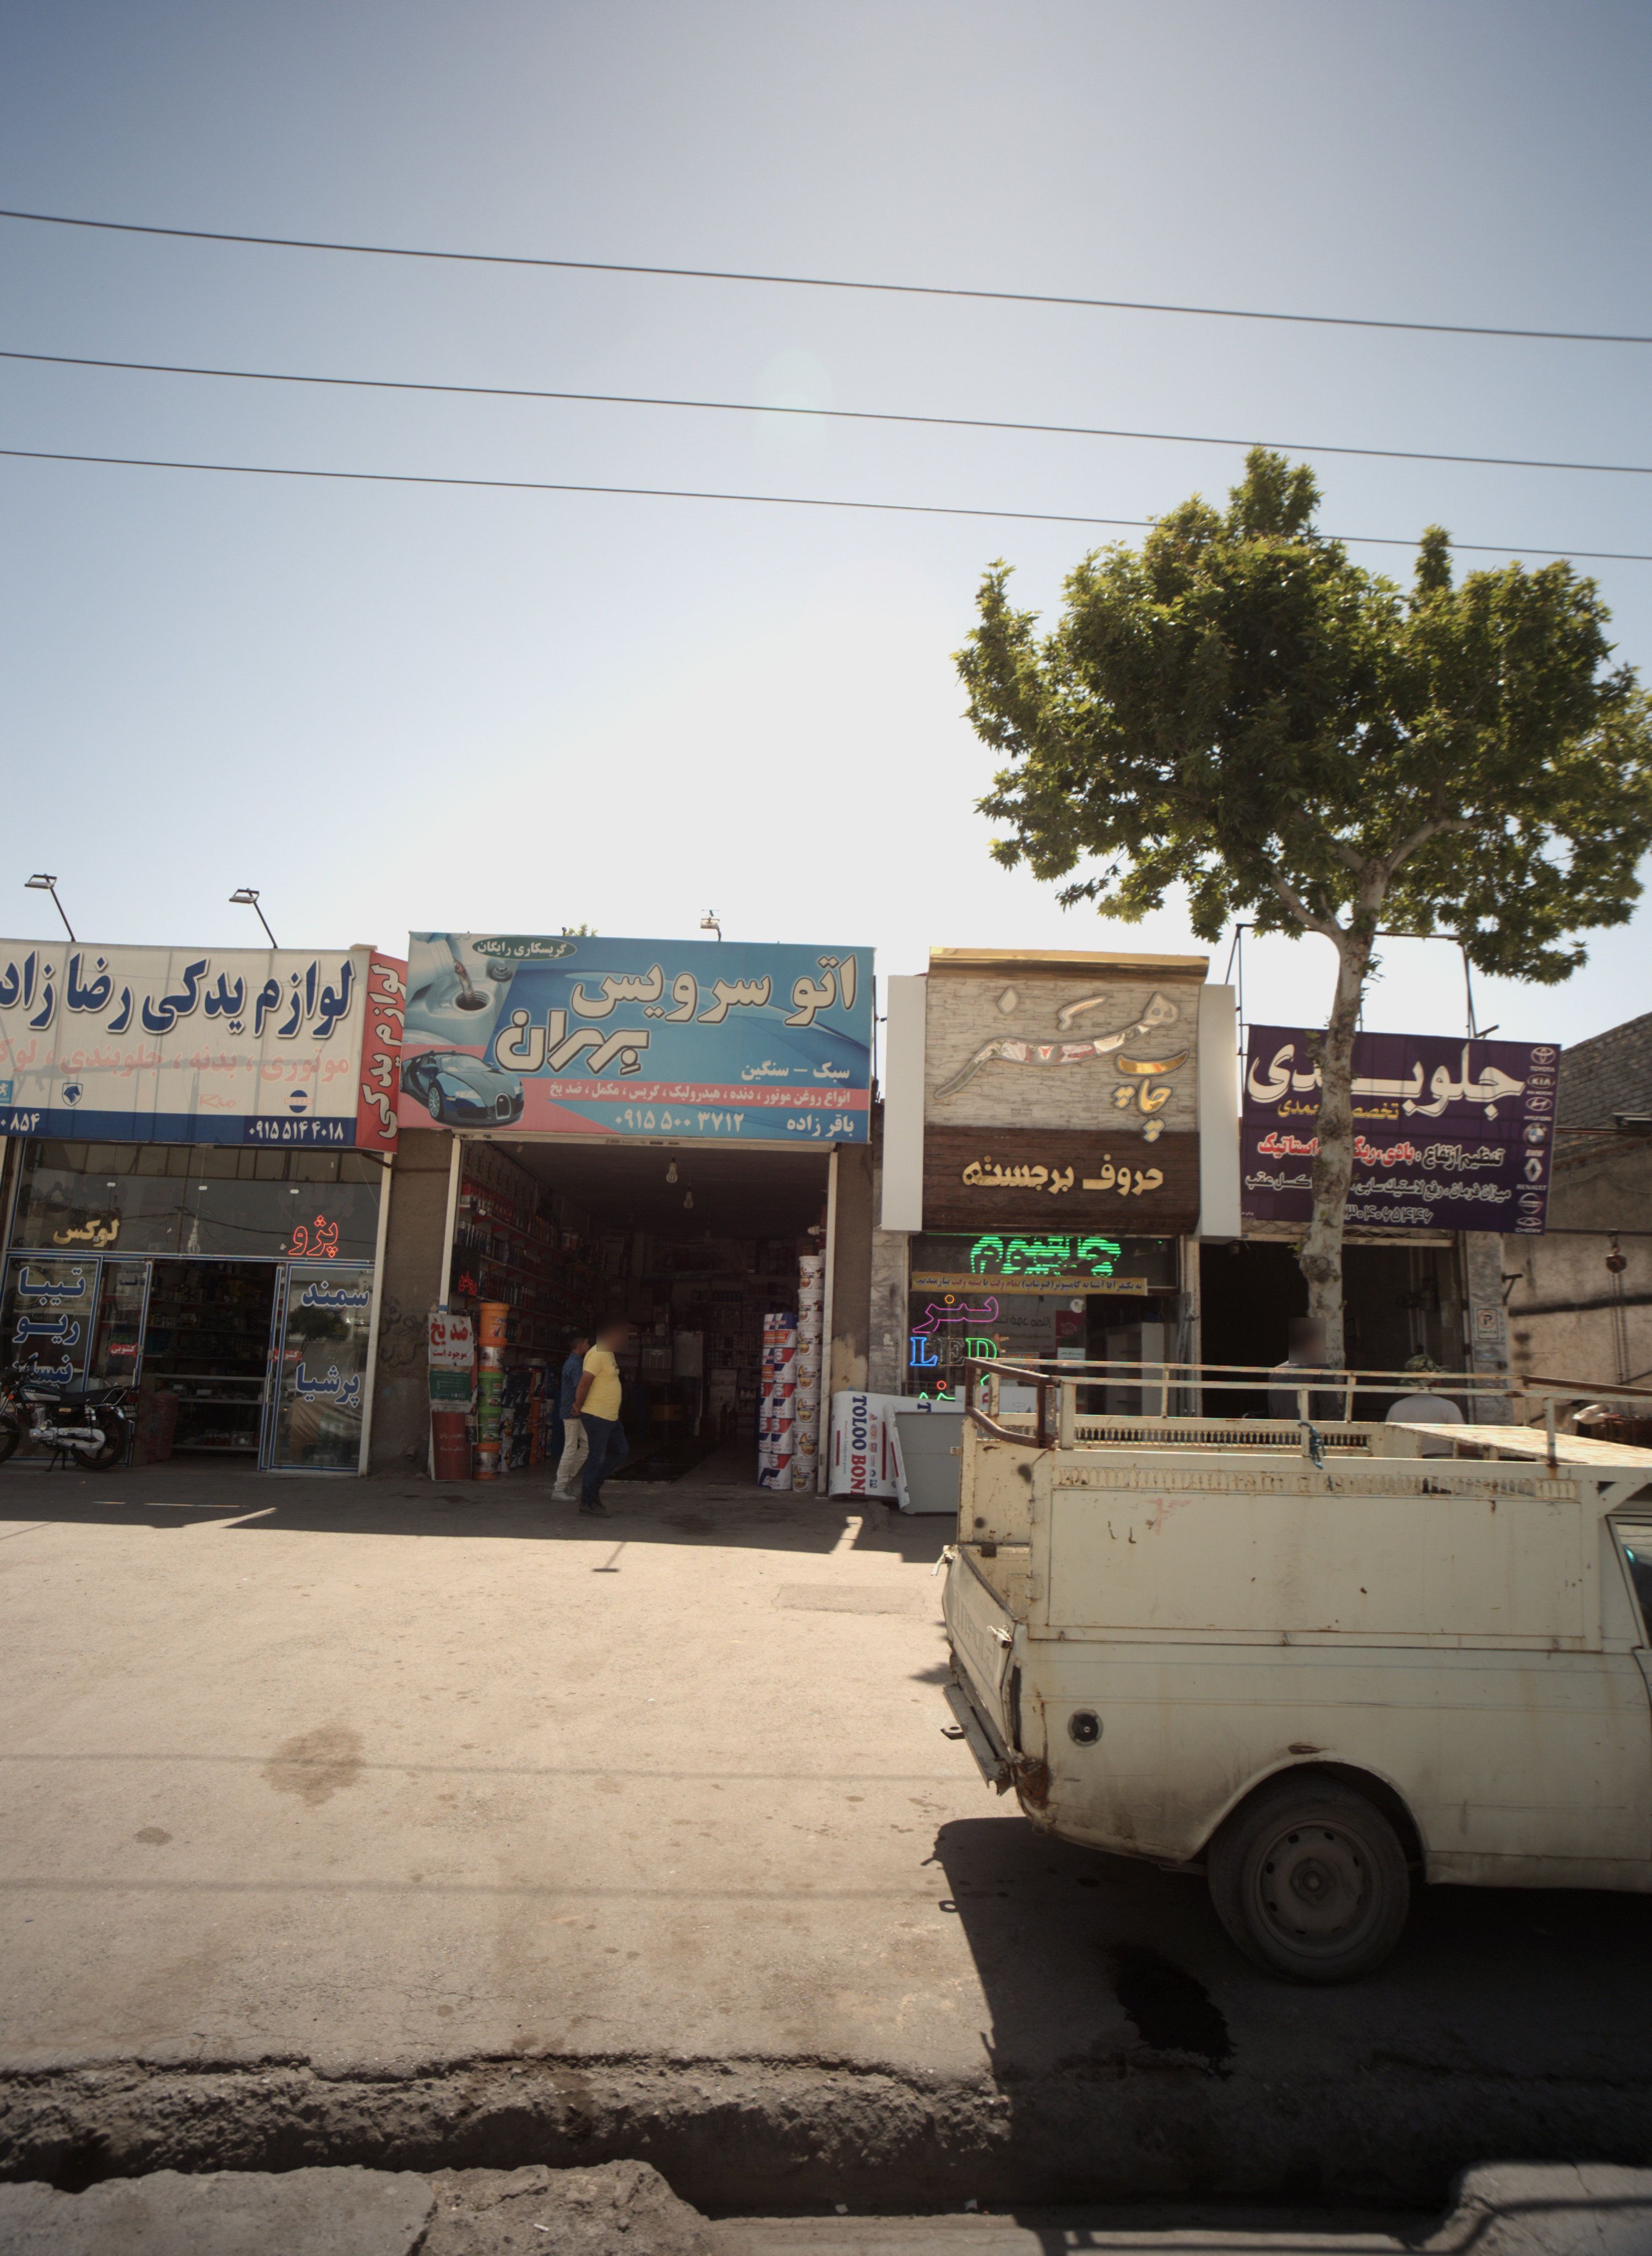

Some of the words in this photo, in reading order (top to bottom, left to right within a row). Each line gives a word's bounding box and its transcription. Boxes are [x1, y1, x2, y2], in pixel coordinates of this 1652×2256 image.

[477, 940, 512, 956] رایگان
[514, 942, 567, 958] گریسکاری
[0, 950, 56, 1031] زاد
[66, 950, 133, 1034] رضا
[140, 957, 245, 1035] یدکی
[252, 958, 356, 1038] لوازم
[571, 964, 771, 1023] سرویس
[784, 954, 857, 1027] اتو
[368, 963, 407, 1046] لوازم
[0, 1037, 39, 1073] لوک
[61, 1042, 165, 1078] جلوبندی
[188, 1044, 238, 1080] بدنه
[260, 1048, 350, 1083] موتوری
[741, 1060, 789, 1080] سنگین
[813, 1061, 850, 1083] سبک
[1247, 1042, 1526, 1120] جلوبدی
[1531, 1077, 1551, 1086] KIA
[361, 1053, 401, 1139] یدکی
[550, 1081, 562, 1097] یخ
[566, 1082, 582, 1094] ضد
[591, 1082, 620, 1098] مکمل
[629, 1084, 660, 1100] گریس
[669, 1084, 720, 1102] هیدرولیک
[730, 1087, 754, 1099] دنده
[763, 1089, 791, 1104] موتور
[794, 1089, 822, 1106] روغن
[824, 1091, 850, 1107] انواع
[615, 1109, 656, 1129] ۰۹۱۵
[661, 1110, 691, 1130] ۵۰۰
[697, 1111, 744, 1132] ۳۷۱۲
[1278, 1099, 1320, 1118] حمدی
[1352, 1102, 1399, 1120] تخصص
[249, 1120, 279, 1139] ۰۹۱۵
[282, 1121, 308, 1140] ۵۱۴
[312, 1121, 344, 1140] ۴۰۱۸
[787, 1113, 821, 1136] زاده
[825, 1114, 854, 1137] باقر
[1257, 1132, 1318, 1159] استاتیک
[1382, 1141, 1415, 1167] بادی
[1421, 1142, 1463, 1171] ارتفاع
[1525, 1149, 1545, 1157] BMW
[1458, 1146, 1506, 1172] تنظیم
[962, 1156, 1074, 1195] برجسته
[1083, 1154, 1164, 1197] حروف
[1449, 1181, 1480, 1201] فرمان
[1480, 1183, 1512, 1203] میزان
[1344, 1204, 1434, 1224] ۳۰۴۰۶۵۴۴۶
[53, 1218, 121, 1248] لوکس
[288, 1214, 339, 1259] پژو
[18, 1266, 86, 1306] تیبا
[301, 1281, 370, 1309] سمند
[12, 1314, 80, 1346] ریو
[431, 1317, 446, 1346] یخ
[450, 1320, 468, 1341] ضد
[448, 1351, 468, 1360] موجود
[910, 1336, 998, 1367] LED
[296, 1362, 361, 1408] پرشیا
[852, 1396, 867, 1451] TOLOO
[850, 1454, 866, 1496] BON
